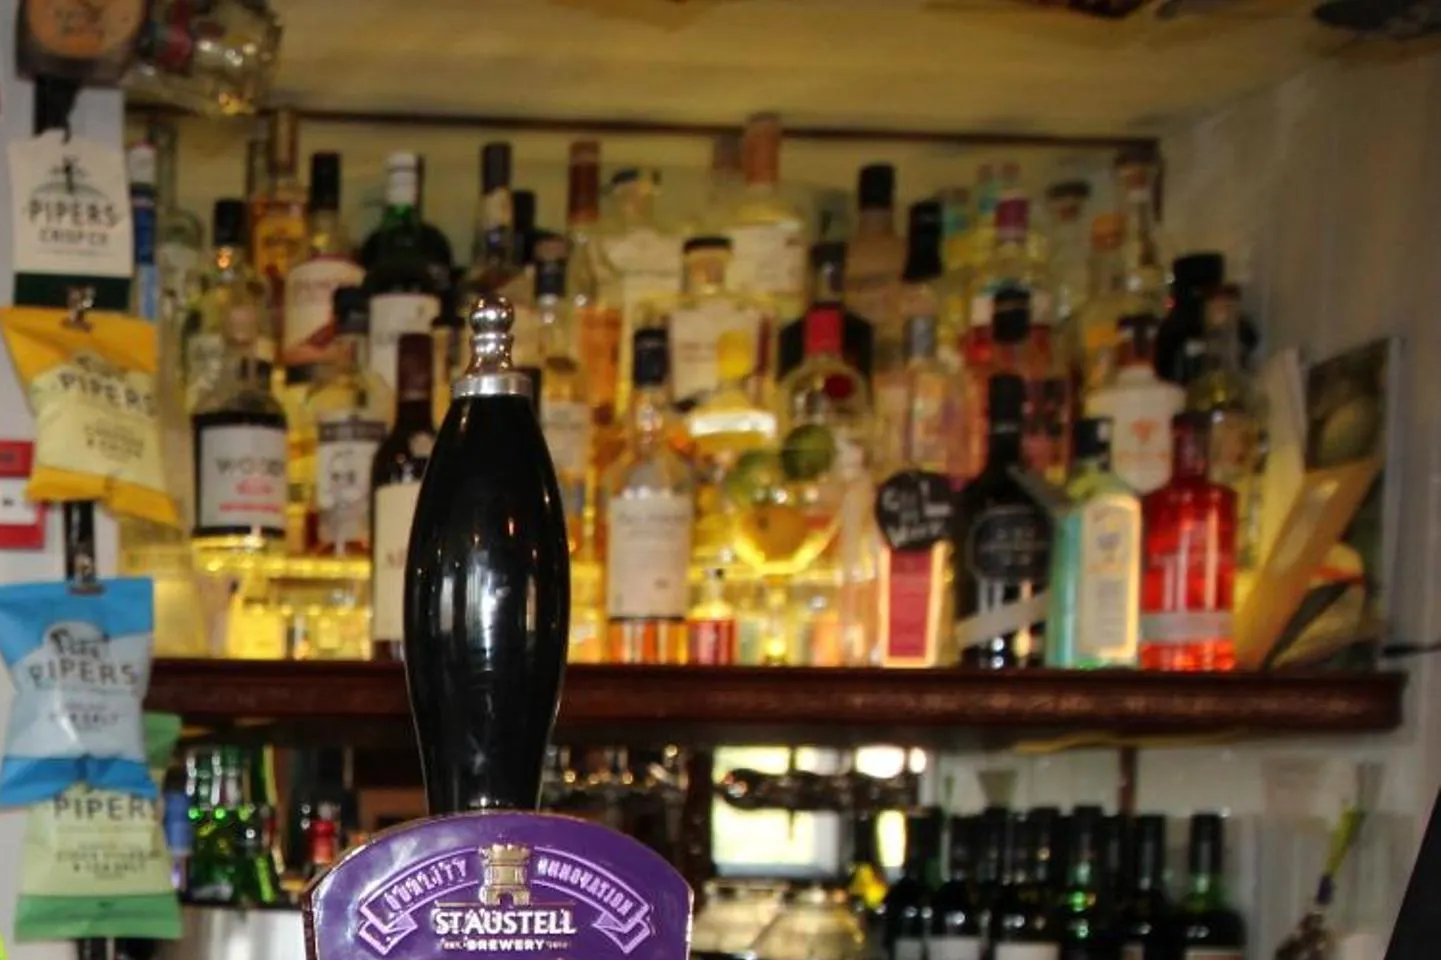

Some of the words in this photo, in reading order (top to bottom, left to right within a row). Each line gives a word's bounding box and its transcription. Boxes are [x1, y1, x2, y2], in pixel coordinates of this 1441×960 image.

[27, 198, 119, 229] PIPERS
[56, 370, 159, 418] PIPERS
[27, 656, 138, 688] PIPERS
[383, 857, 467, 911] QUALITY
[466, 938, 545, 952] BREWERY
